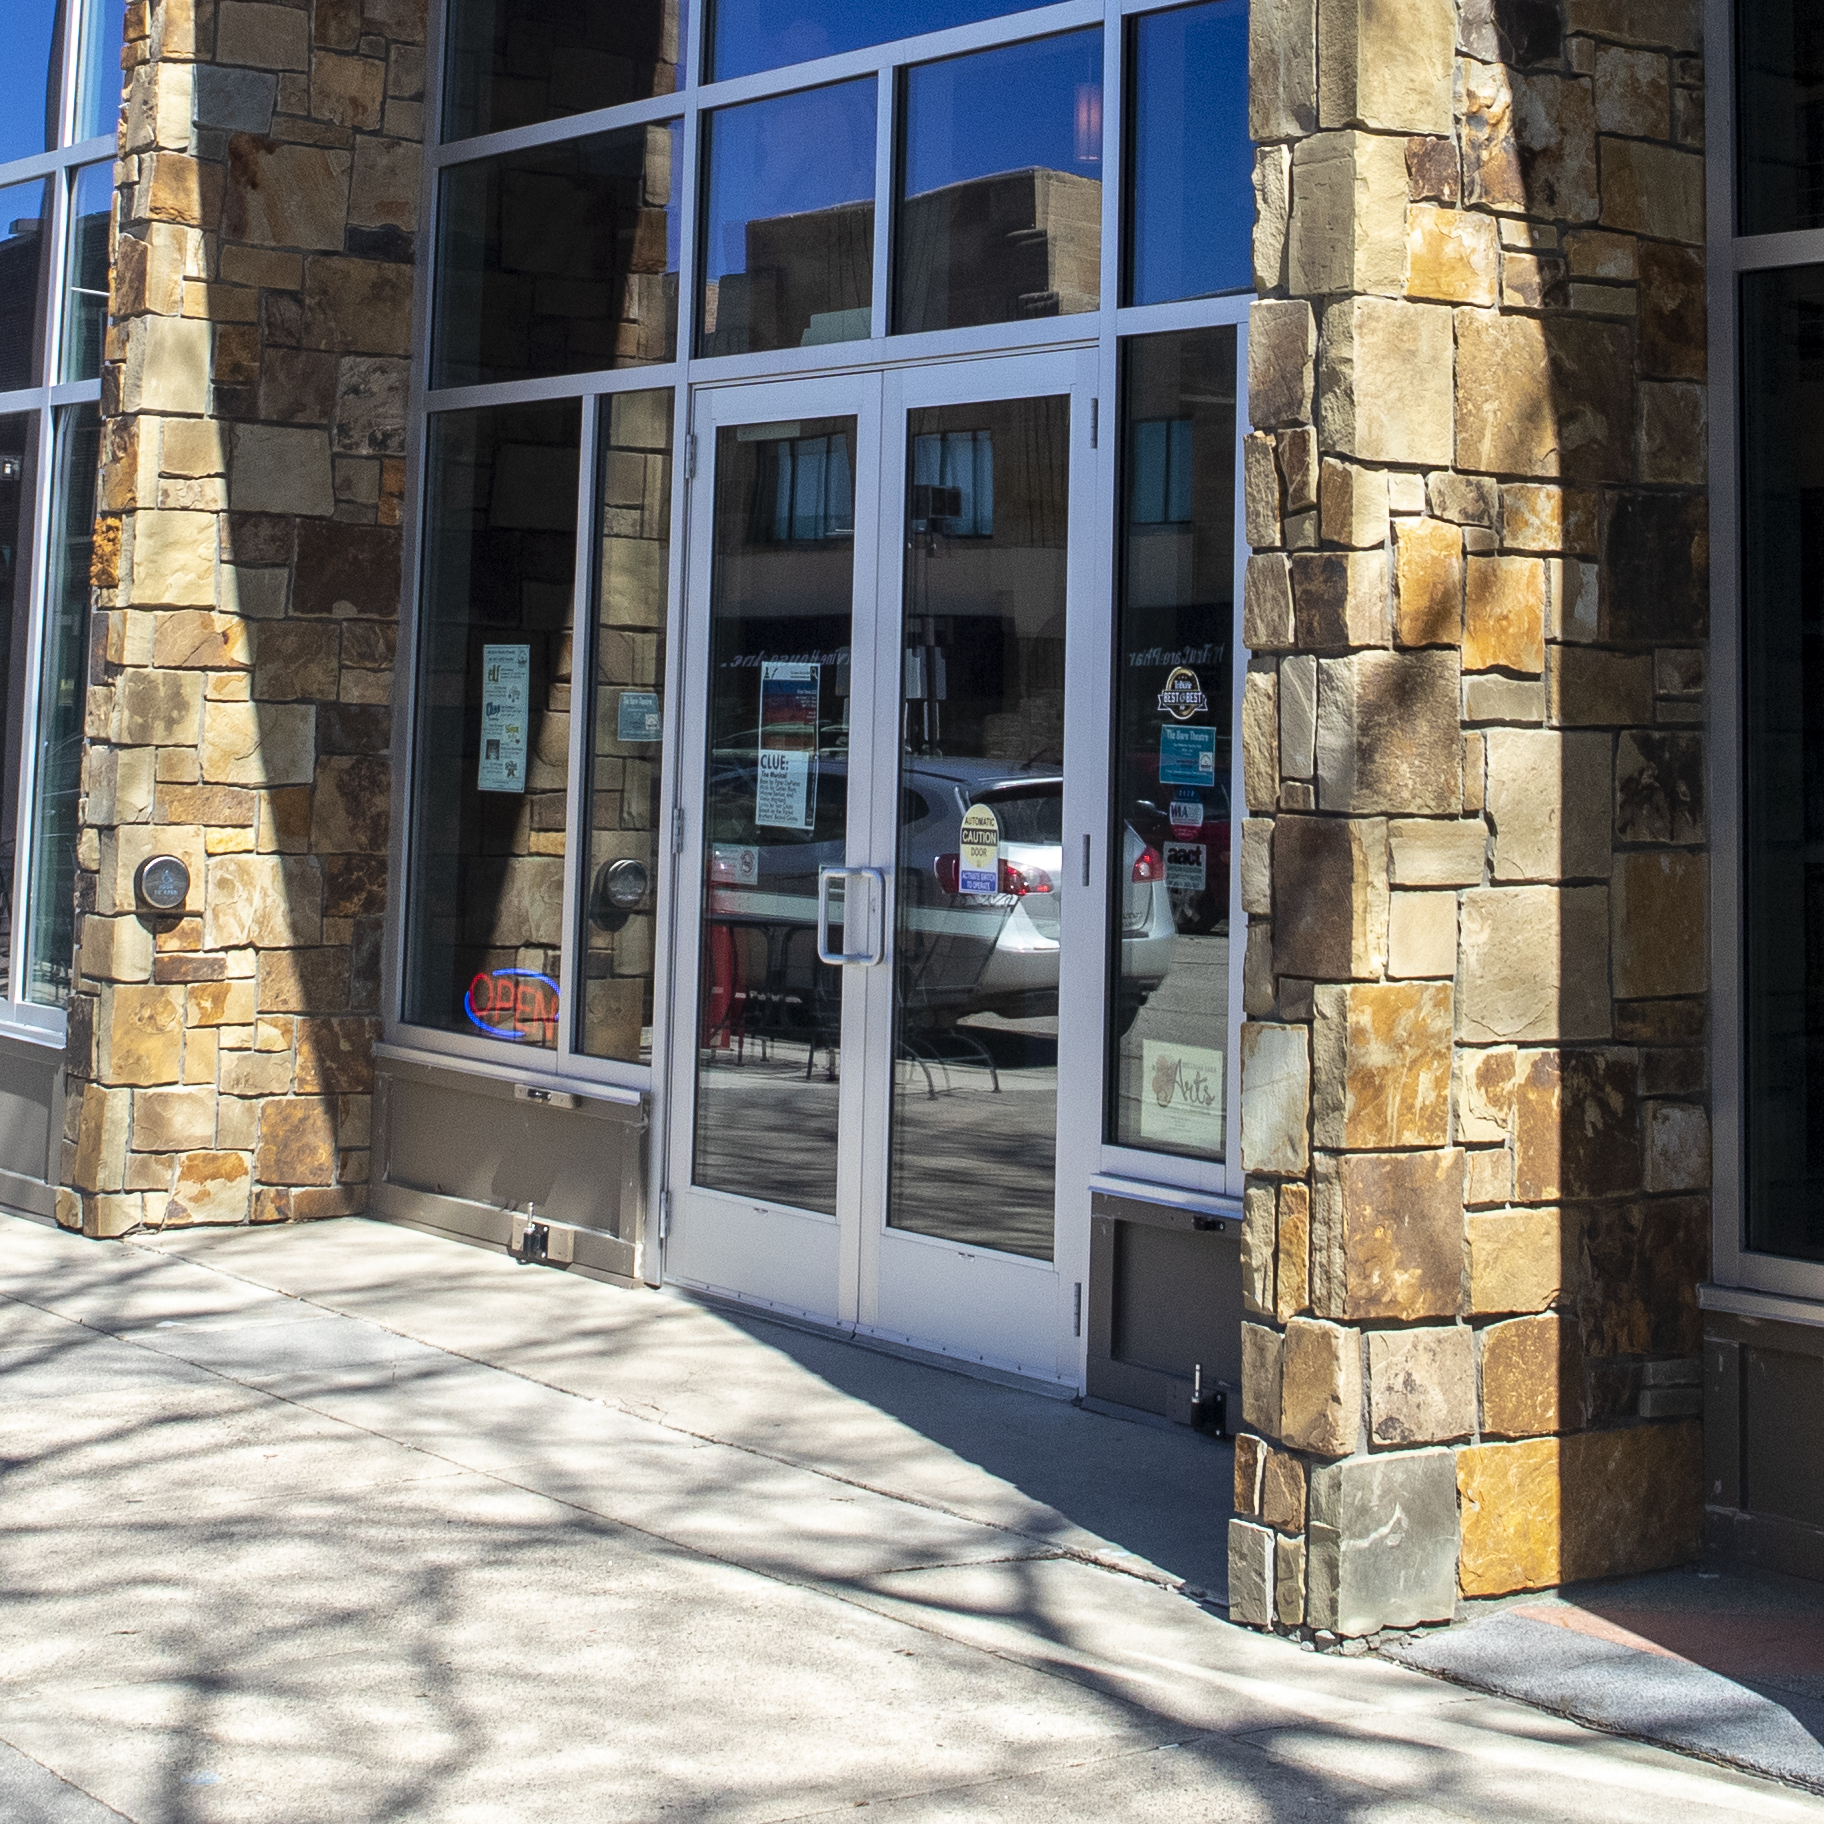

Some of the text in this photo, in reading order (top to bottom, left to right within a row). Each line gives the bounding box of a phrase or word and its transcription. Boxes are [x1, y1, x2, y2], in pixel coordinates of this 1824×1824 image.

[1163, 692, 1180, 703] BEST
[1185, 692, 1202, 703] BEST
[965, 816, 995, 826] AUTOMATIC
[962, 830, 997, 844] CAUTION
[970, 847, 987, 857] DOOR
[1167, 844, 1202, 866] aact
[469, 973, 558, 1040] OPEN
[1175, 1058, 1216, 1106] Arts
